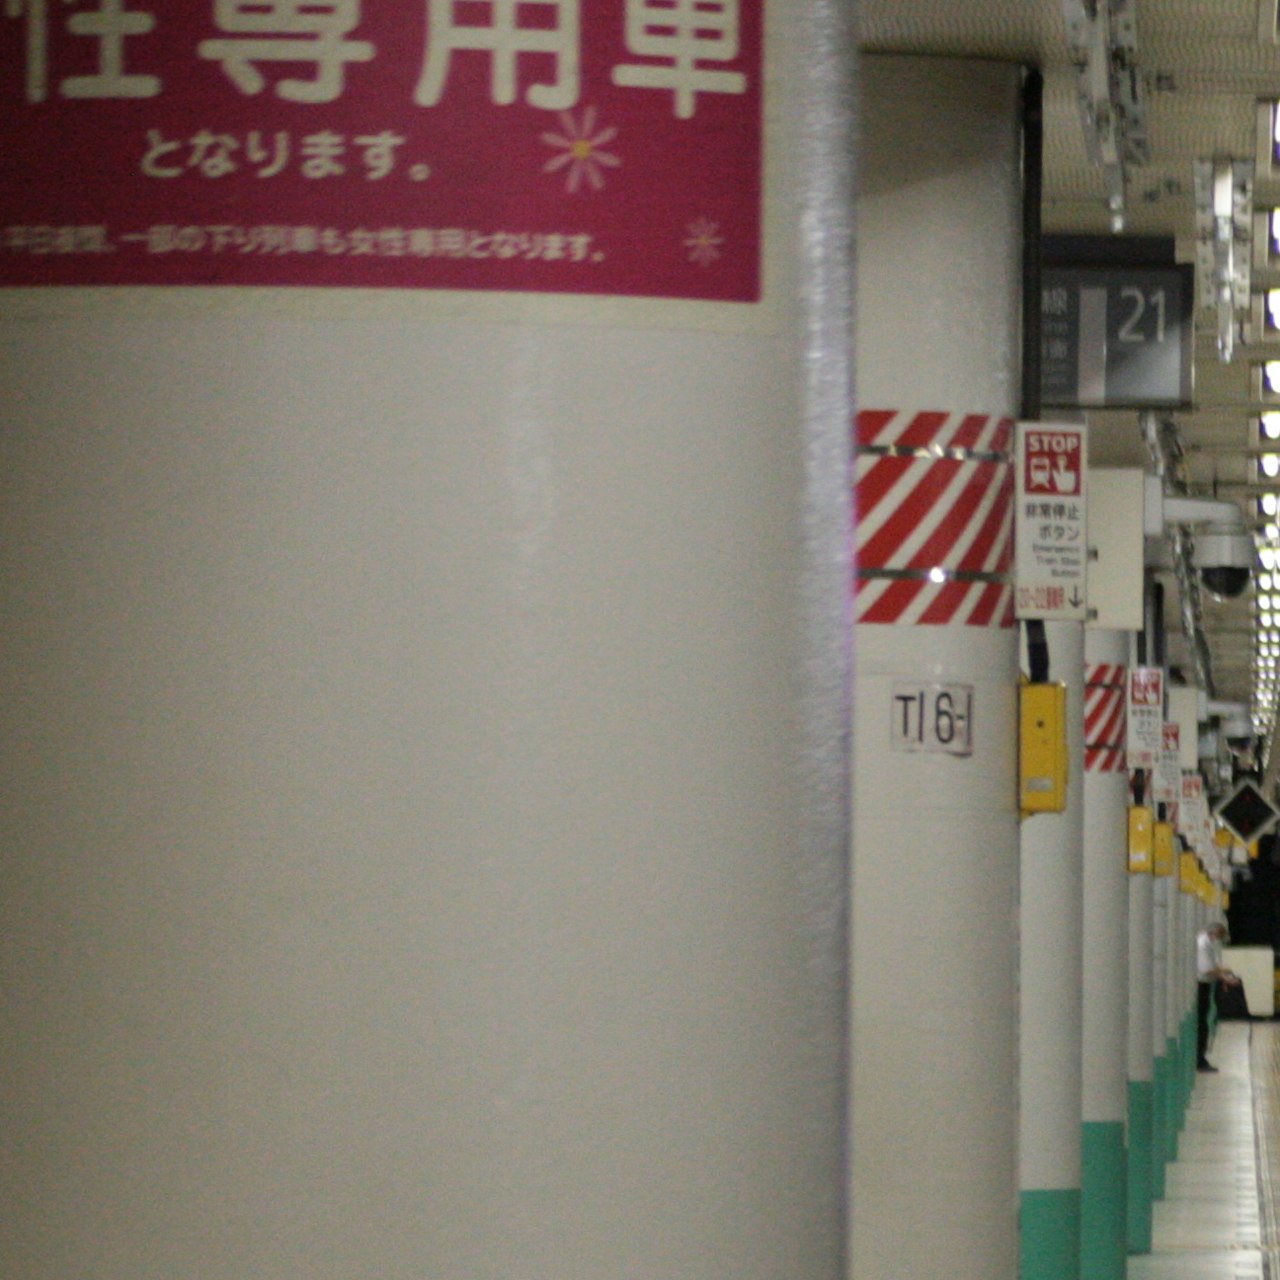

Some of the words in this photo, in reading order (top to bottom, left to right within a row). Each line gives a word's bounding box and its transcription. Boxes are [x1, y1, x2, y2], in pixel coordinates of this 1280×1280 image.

[140, 130, 432, 182] となります。
[1118, 285, 1167, 342] 21
[1029, 434, 1079, 453] STOP
